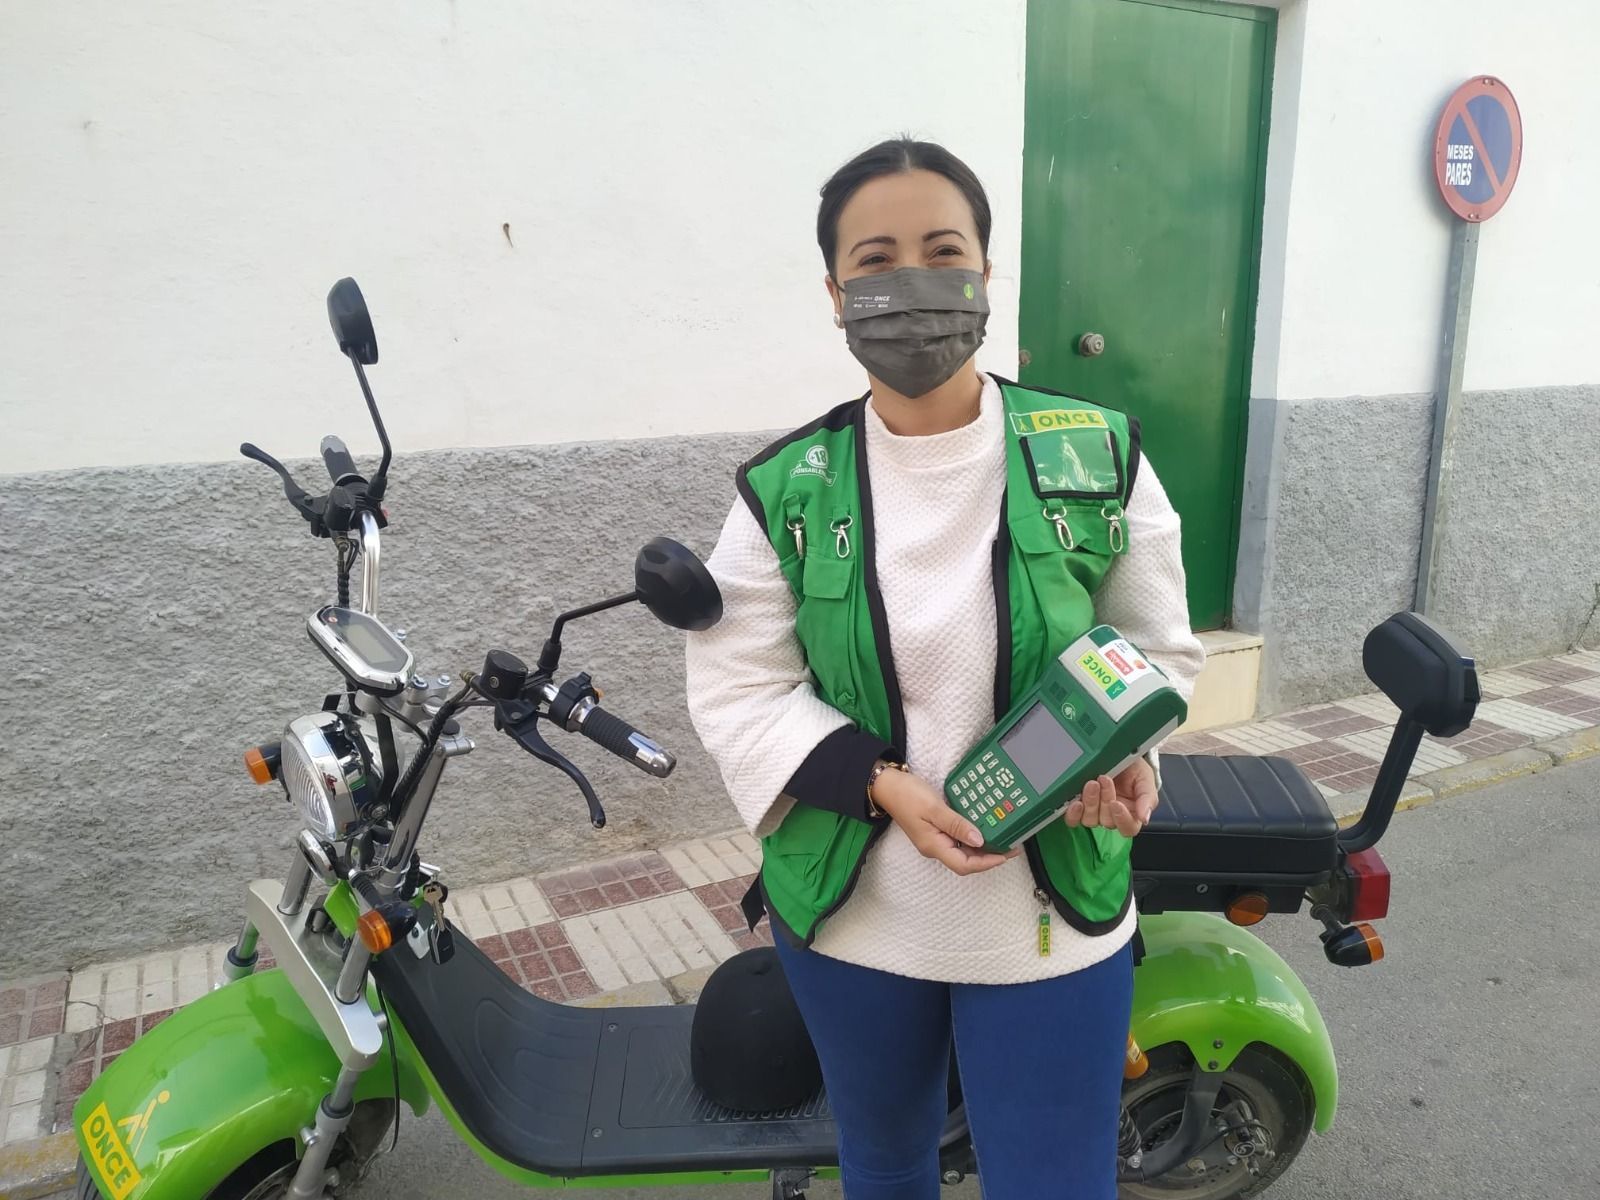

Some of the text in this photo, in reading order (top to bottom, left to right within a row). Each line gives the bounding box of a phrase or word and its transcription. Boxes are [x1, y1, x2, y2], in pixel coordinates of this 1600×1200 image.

[1447, 144, 1474, 160] MESES
[1445, 162, 1472, 186] PARES
[1038, 413, 1101, 427] ONCE
[810, 450, 827, 464] +18
[1083, 655, 1112, 685] ONCE
[1041, 927, 1049, 954] ONCE
[90, 1115, 132, 1190] ONCE
